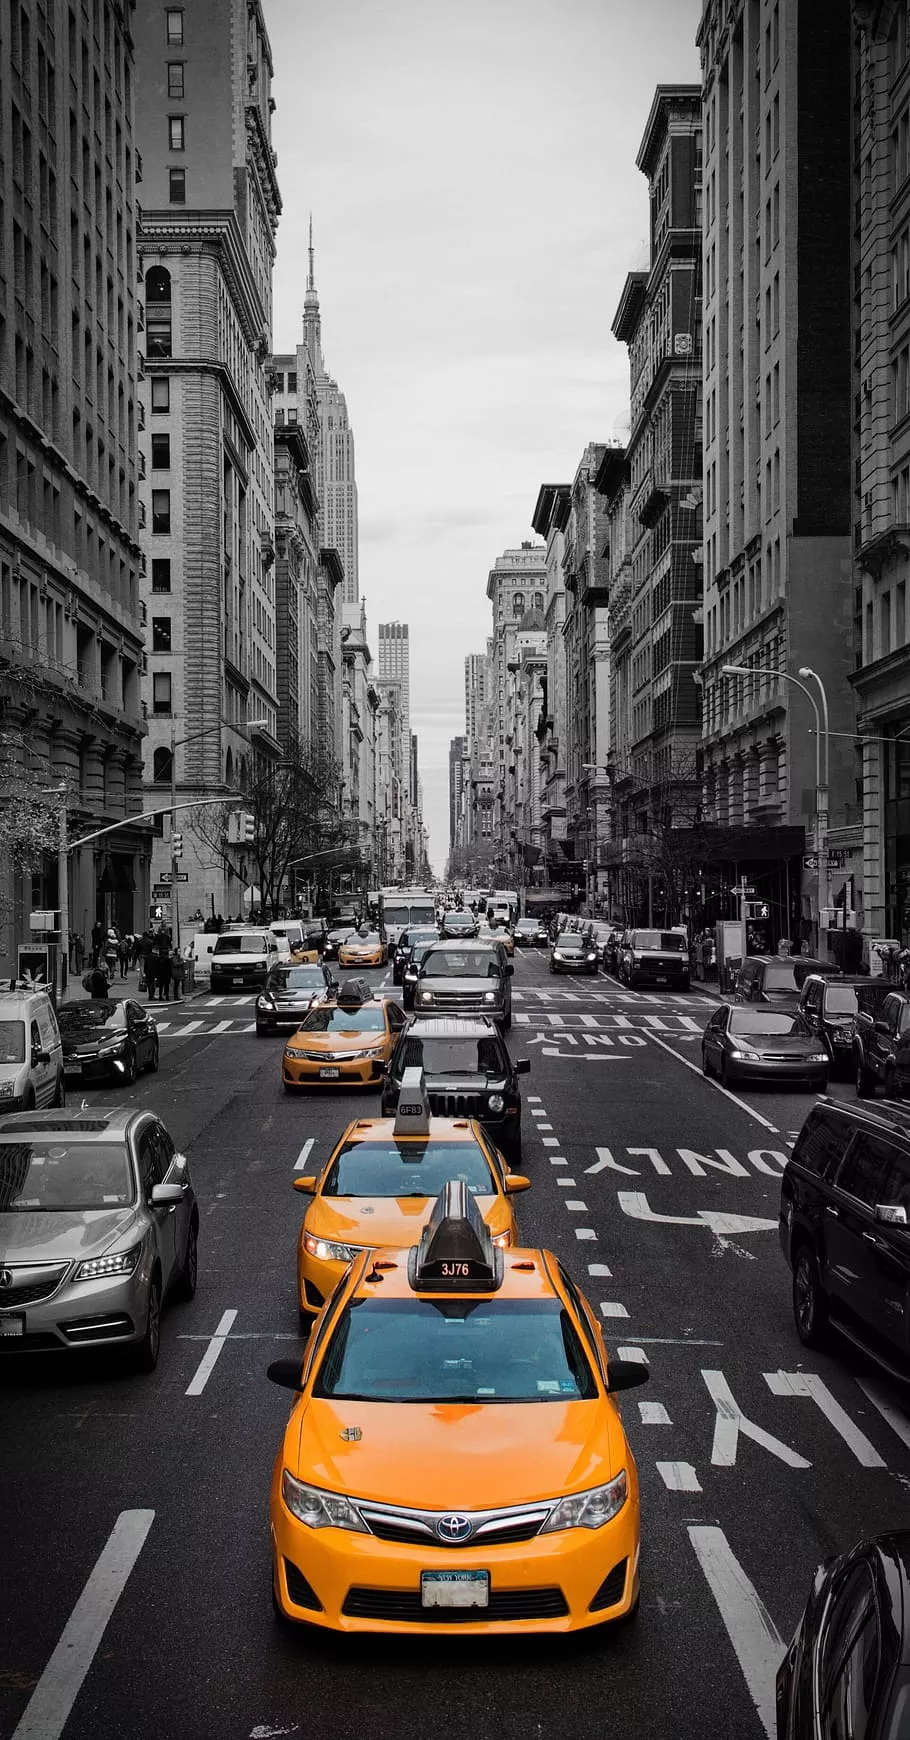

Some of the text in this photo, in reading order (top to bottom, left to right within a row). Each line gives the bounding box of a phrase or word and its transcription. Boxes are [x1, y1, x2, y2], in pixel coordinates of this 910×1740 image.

[526, 1033, 648, 1046] ONLY
[583, 1147, 789, 1177] ONLY
[441, 1262, 469, 1276] 3J76
